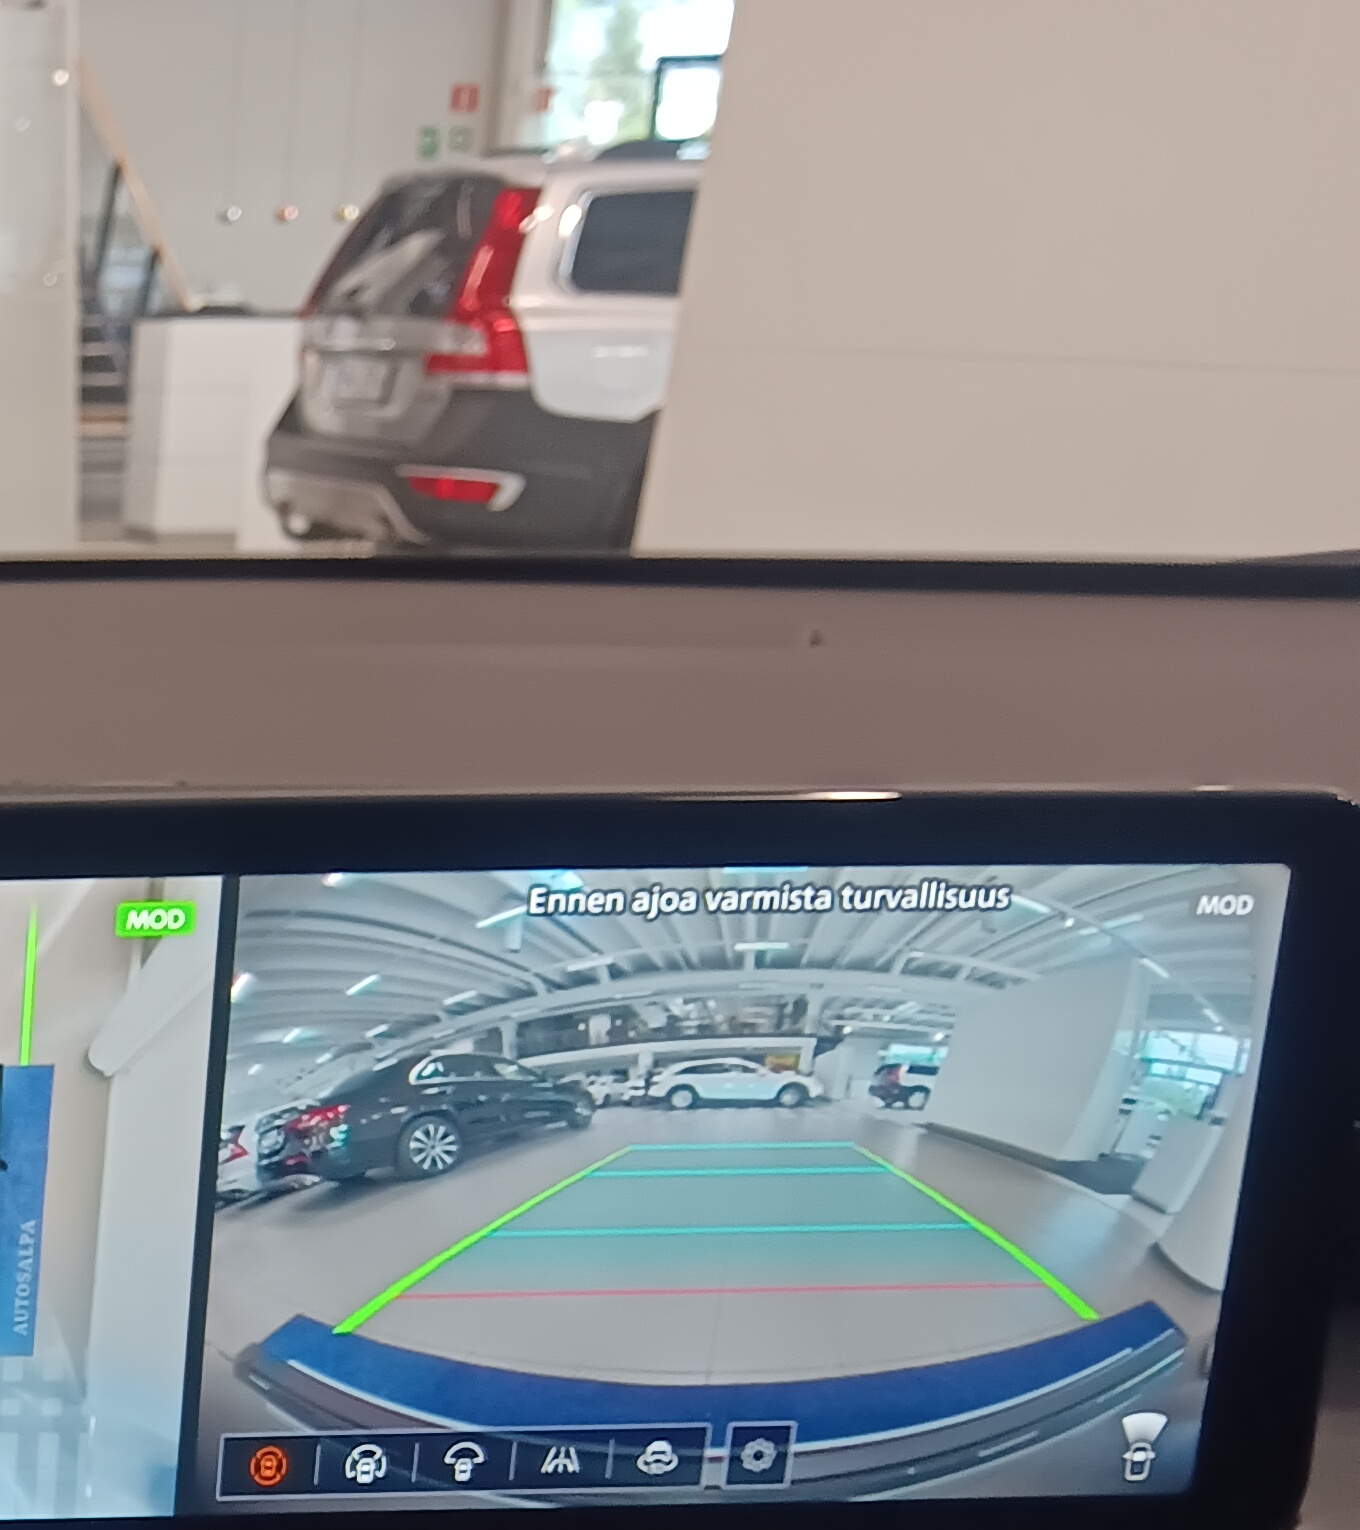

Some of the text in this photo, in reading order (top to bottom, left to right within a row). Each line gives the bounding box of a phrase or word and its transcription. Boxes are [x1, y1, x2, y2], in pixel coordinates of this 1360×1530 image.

[530, 881, 1010, 920] Ennen ajoa varmista turvallisuus
[1196, 895, 1253, 916] MOD
[125, 907, 186, 930] MOD
[13, 1219, 37, 1336] AUTOSALPA
